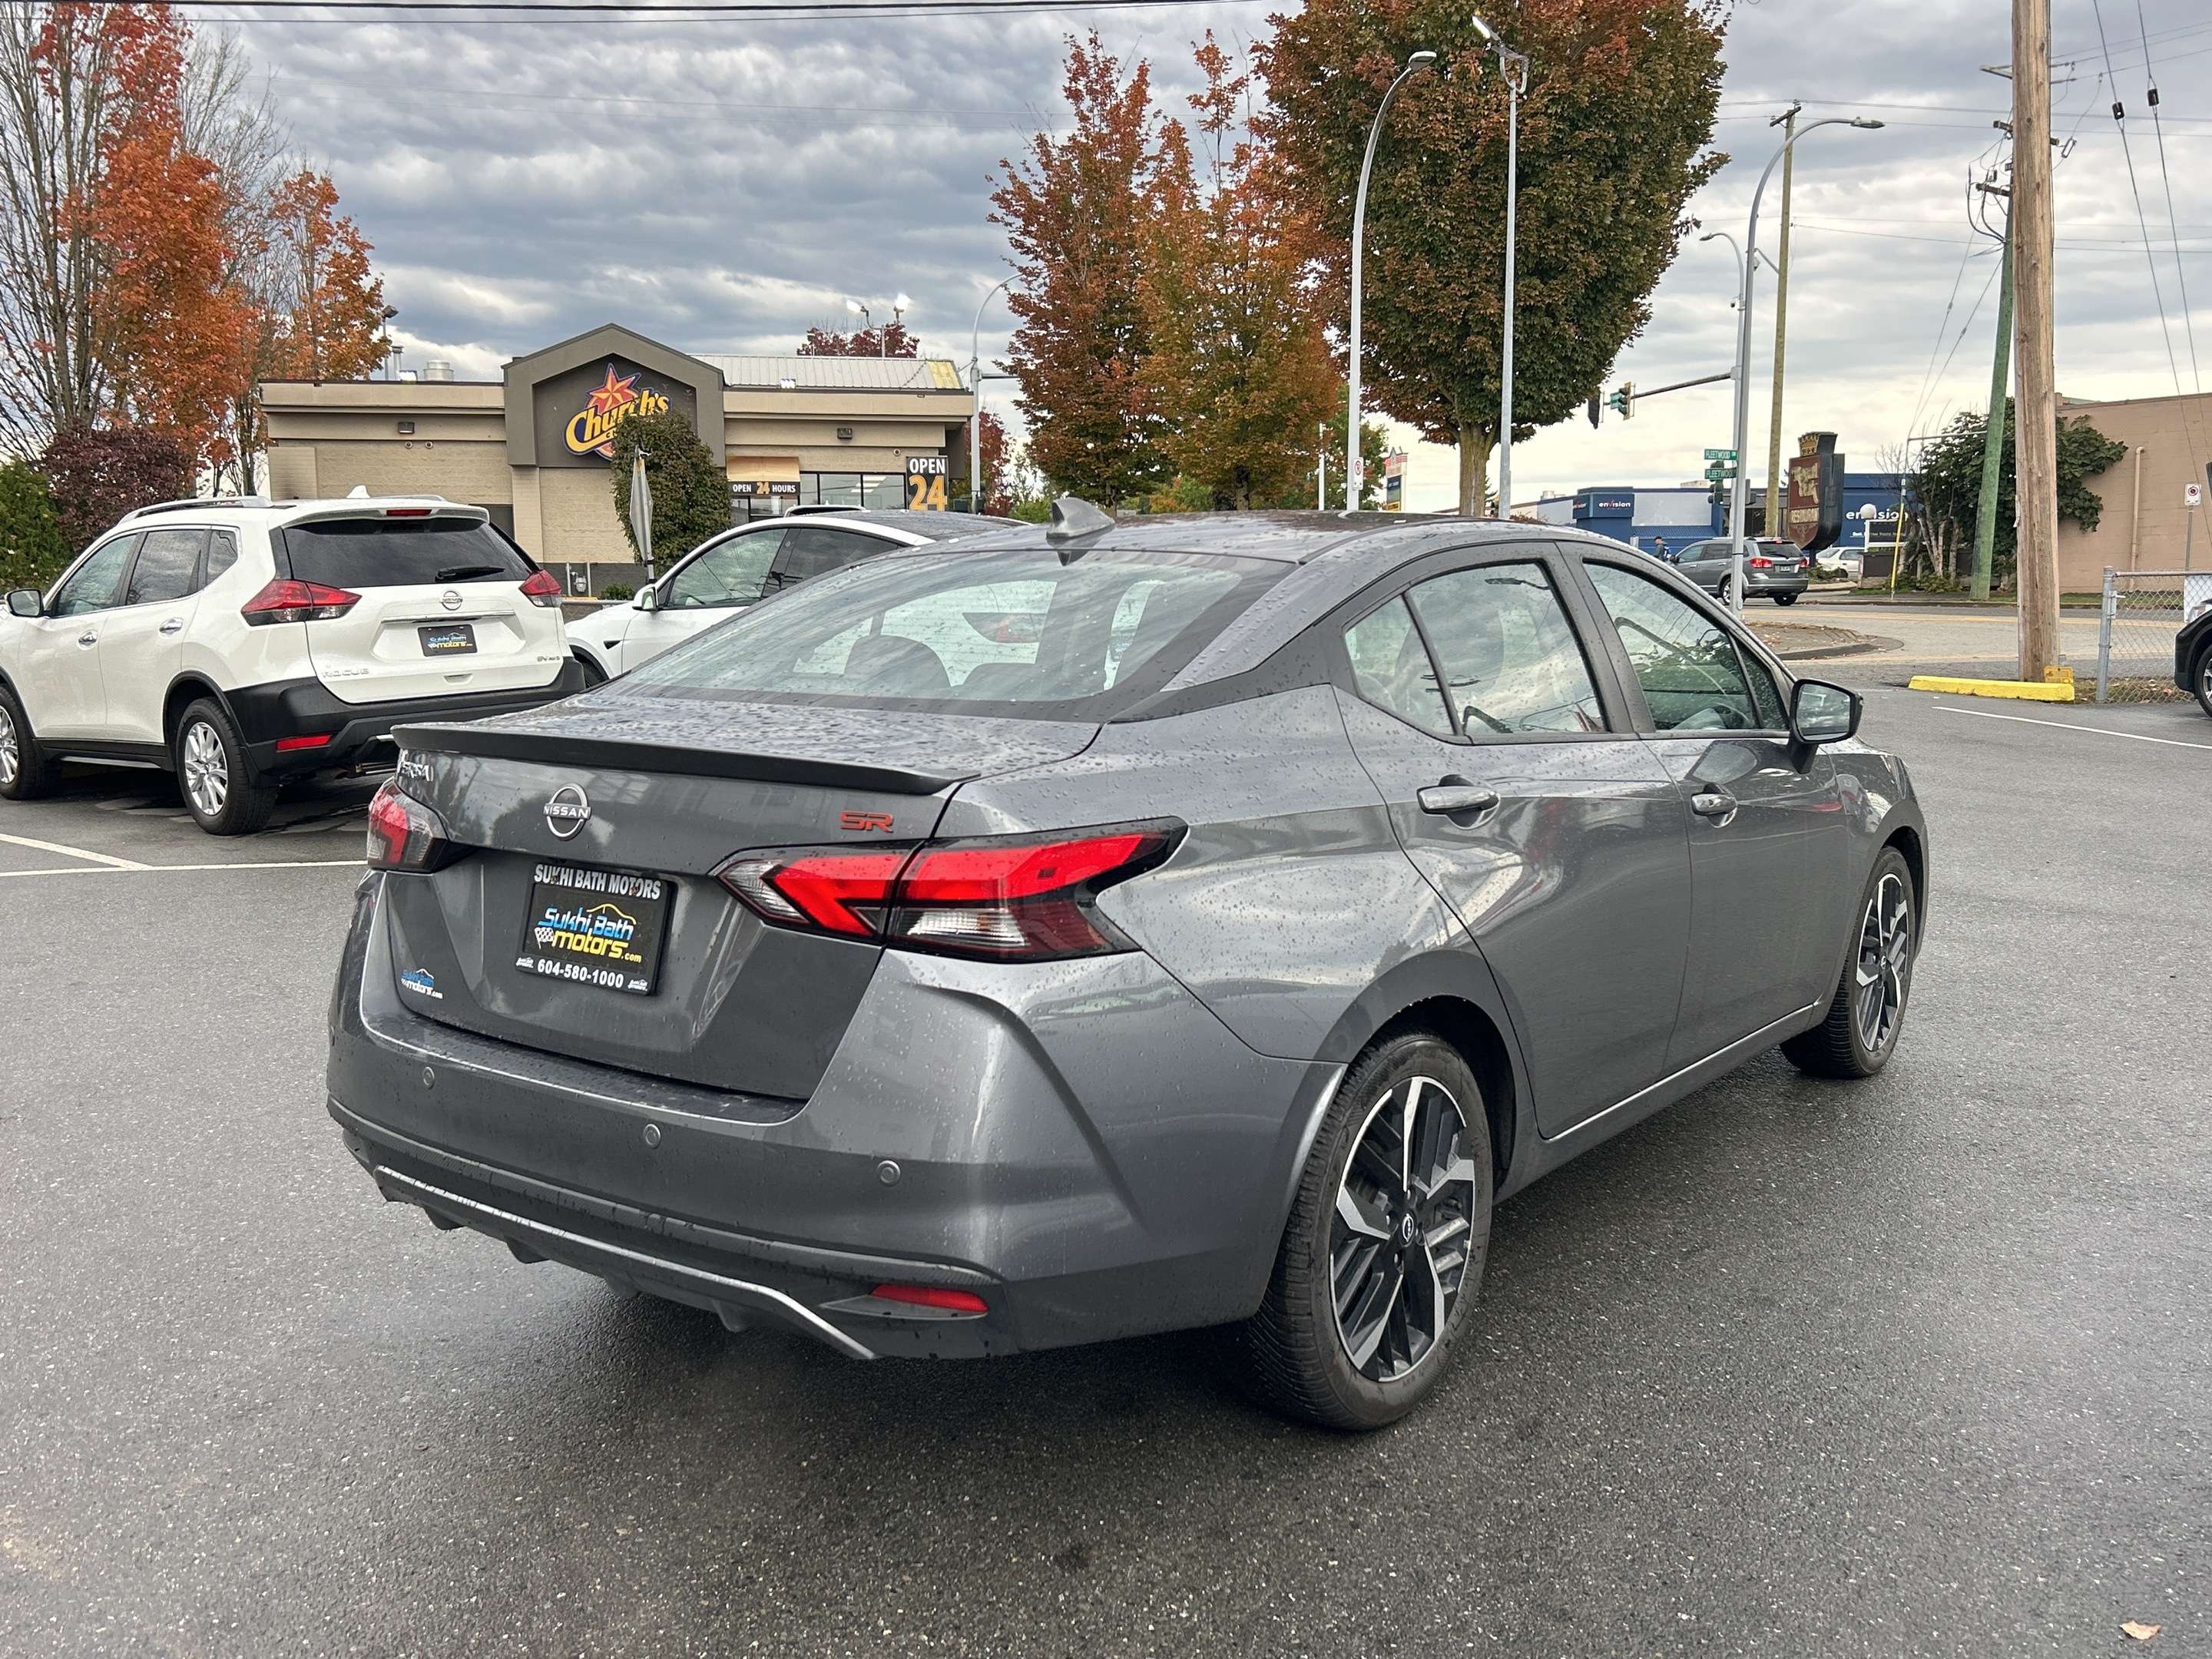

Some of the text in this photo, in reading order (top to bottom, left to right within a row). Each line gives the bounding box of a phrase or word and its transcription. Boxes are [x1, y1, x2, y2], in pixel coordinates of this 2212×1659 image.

[909, 458, 945, 474] OPEN
[1705, 450, 1730, 459] FLEETWOOD
[732, 482, 796, 494] OPEN 24 HOURS
[909, 475, 948, 512] 24
[544, 805, 589, 819] NISSAN
[837, 810, 894, 833] SR
[534, 864, 661, 900] SUKHI BATH MOTORS
[538, 907, 634, 940] Sukhi Bath
[537, 959, 624, 988] 604-580-1000
